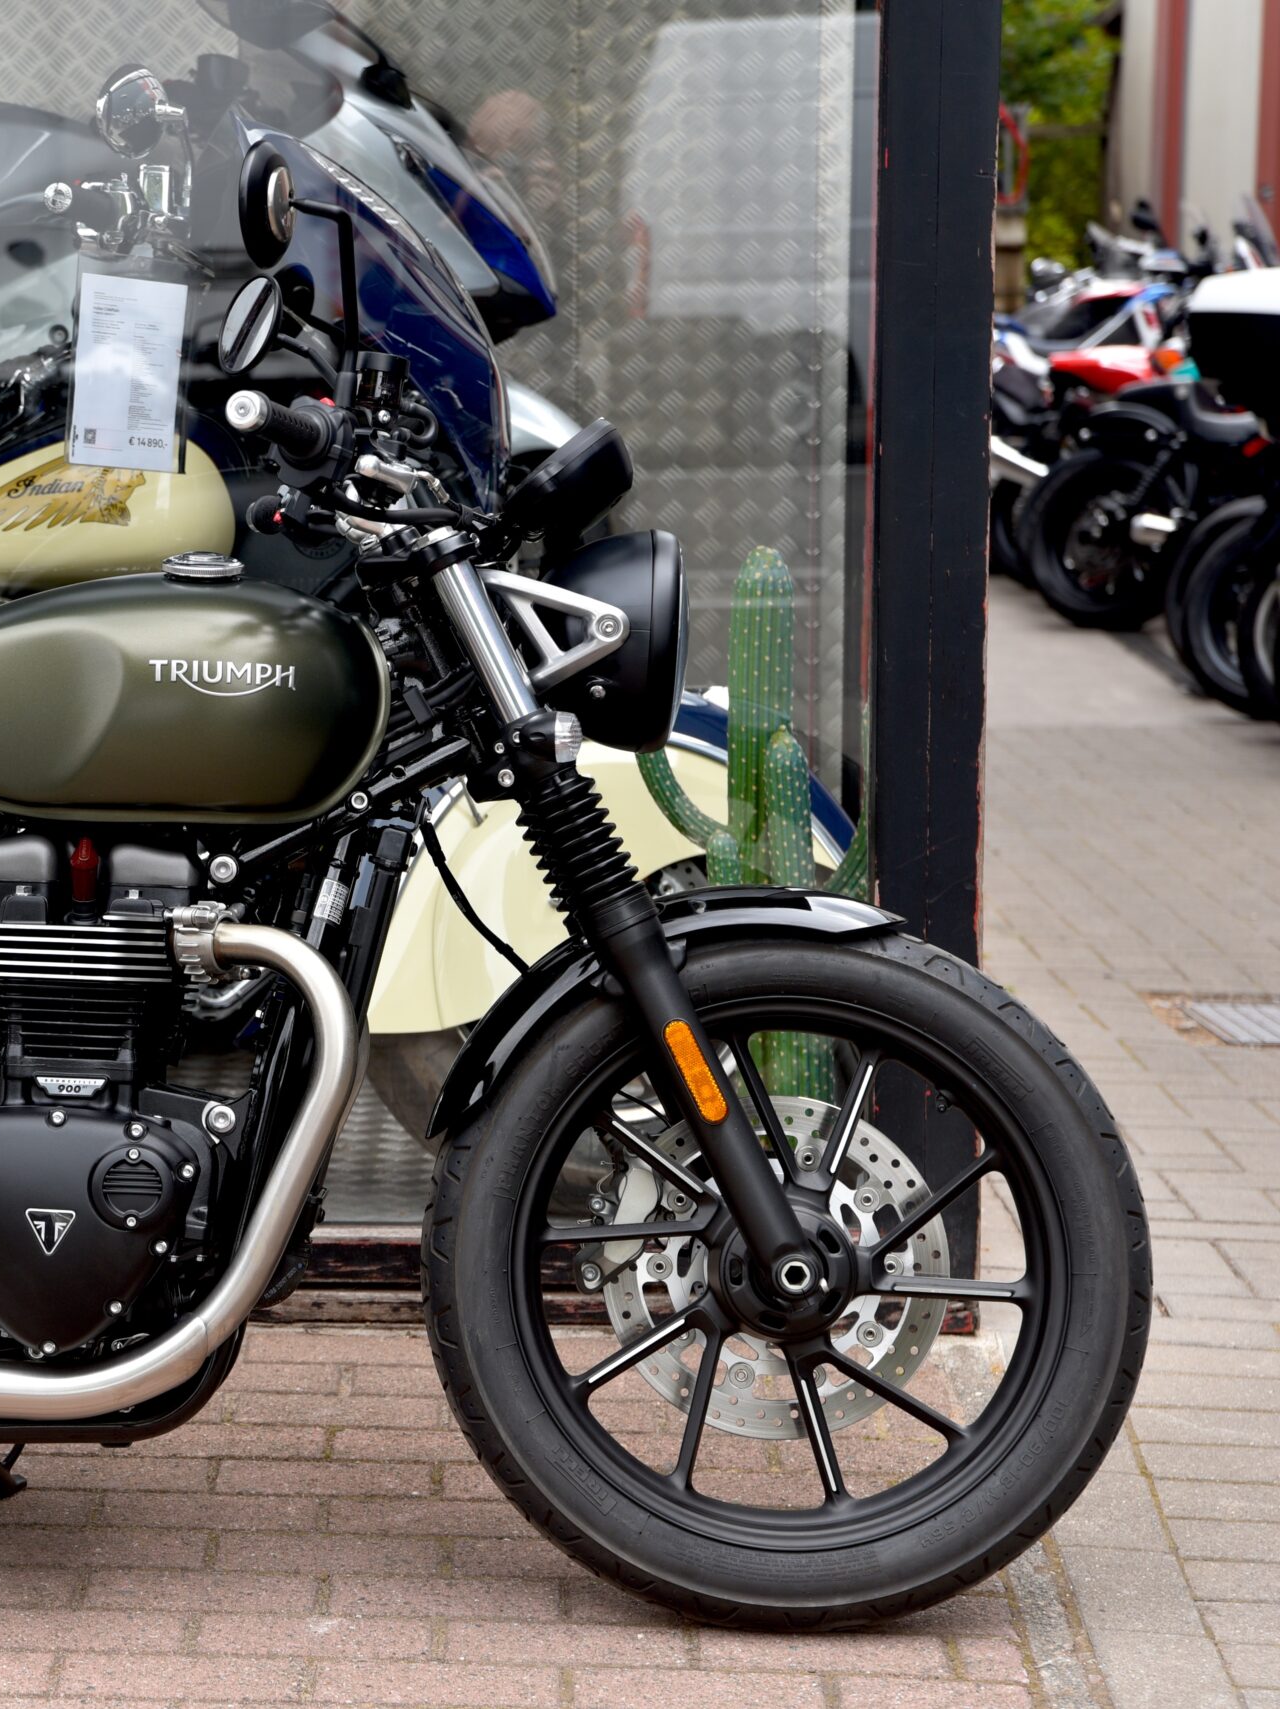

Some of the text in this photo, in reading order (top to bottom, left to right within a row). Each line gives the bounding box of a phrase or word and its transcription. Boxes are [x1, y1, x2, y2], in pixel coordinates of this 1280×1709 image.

[7, 475, 84, 499] Indian
[148, 659, 296, 697] TRIUMPH
[57, 1084, 81, 1093] 900
[544, 1446, 617, 1516] PIRELLI
